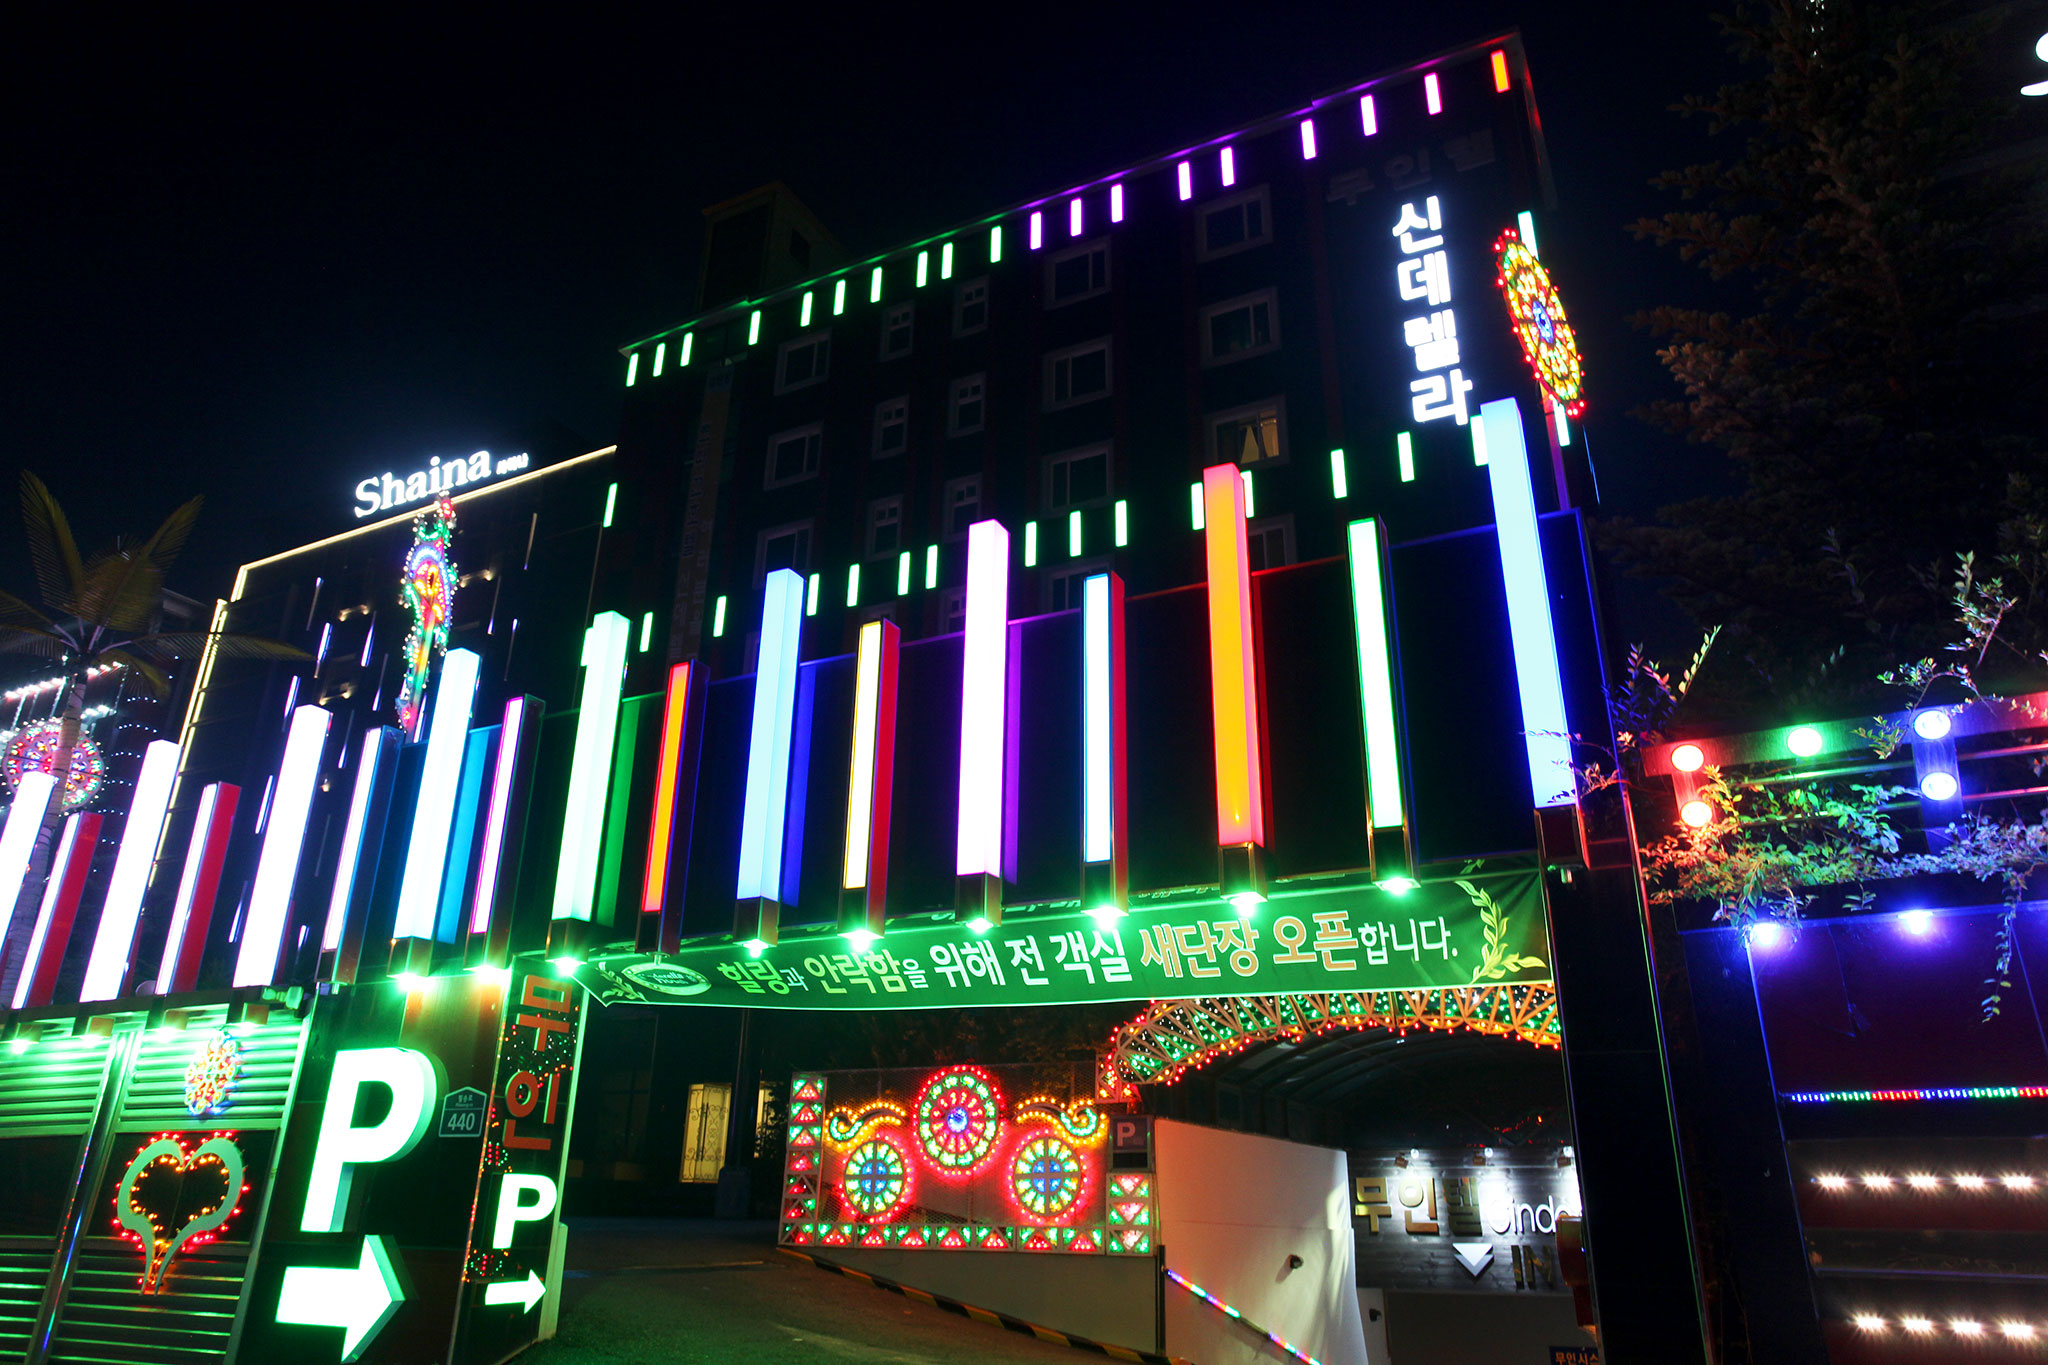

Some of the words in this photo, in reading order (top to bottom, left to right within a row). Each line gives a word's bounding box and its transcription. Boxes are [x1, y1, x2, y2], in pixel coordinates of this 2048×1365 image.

[354, 451, 492, 518] Shaina
[716, 959, 809, 995] 힐링과
[803, 949, 929, 994] 안락함을
[931, 938, 1006, 987] 위해
[1006, 934, 1050, 986] 전
[1052, 928, 1133, 984] 객실
[1140, 917, 1260, 979] 새단장
[1272, 910, 1358, 972] 오픈
[1358, 916, 1458, 966] 합니다.
[300, 1047, 437, 1232] P
[447, 1112, 475, 1131] 440
[1117, 1122, 1136, 1147] P
[492, 1173, 557, 1249] P
[1355, 1177, 1483, 1236] 무인텔
[1511, 1245, 1554, 1288] IN
